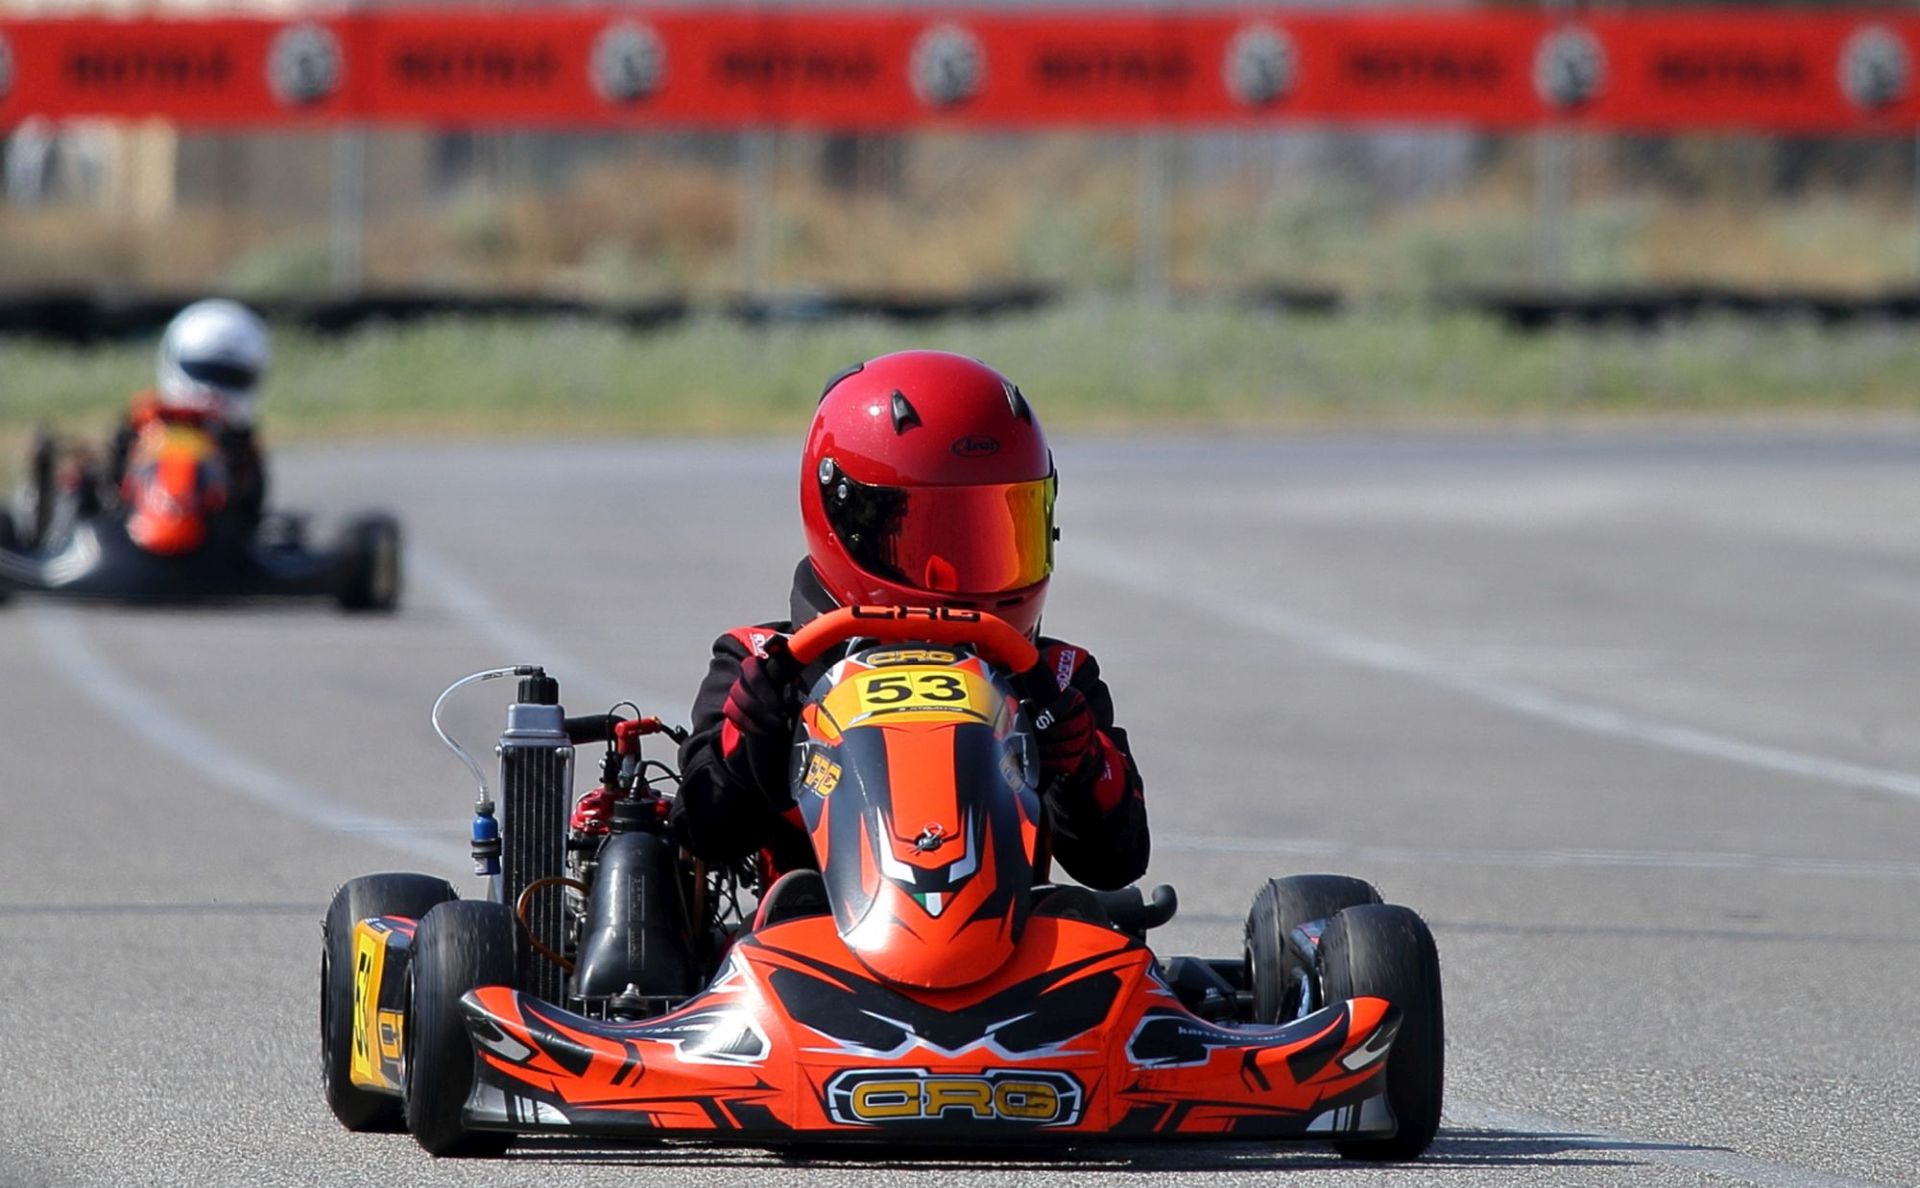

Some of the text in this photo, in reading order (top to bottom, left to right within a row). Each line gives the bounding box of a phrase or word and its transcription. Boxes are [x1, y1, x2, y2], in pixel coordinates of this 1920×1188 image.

[851, 605, 981, 622] CRG
[867, 650, 956, 665] CRG
[866, 675, 967, 704] 53
[852, 1079, 1060, 1120] CRG
